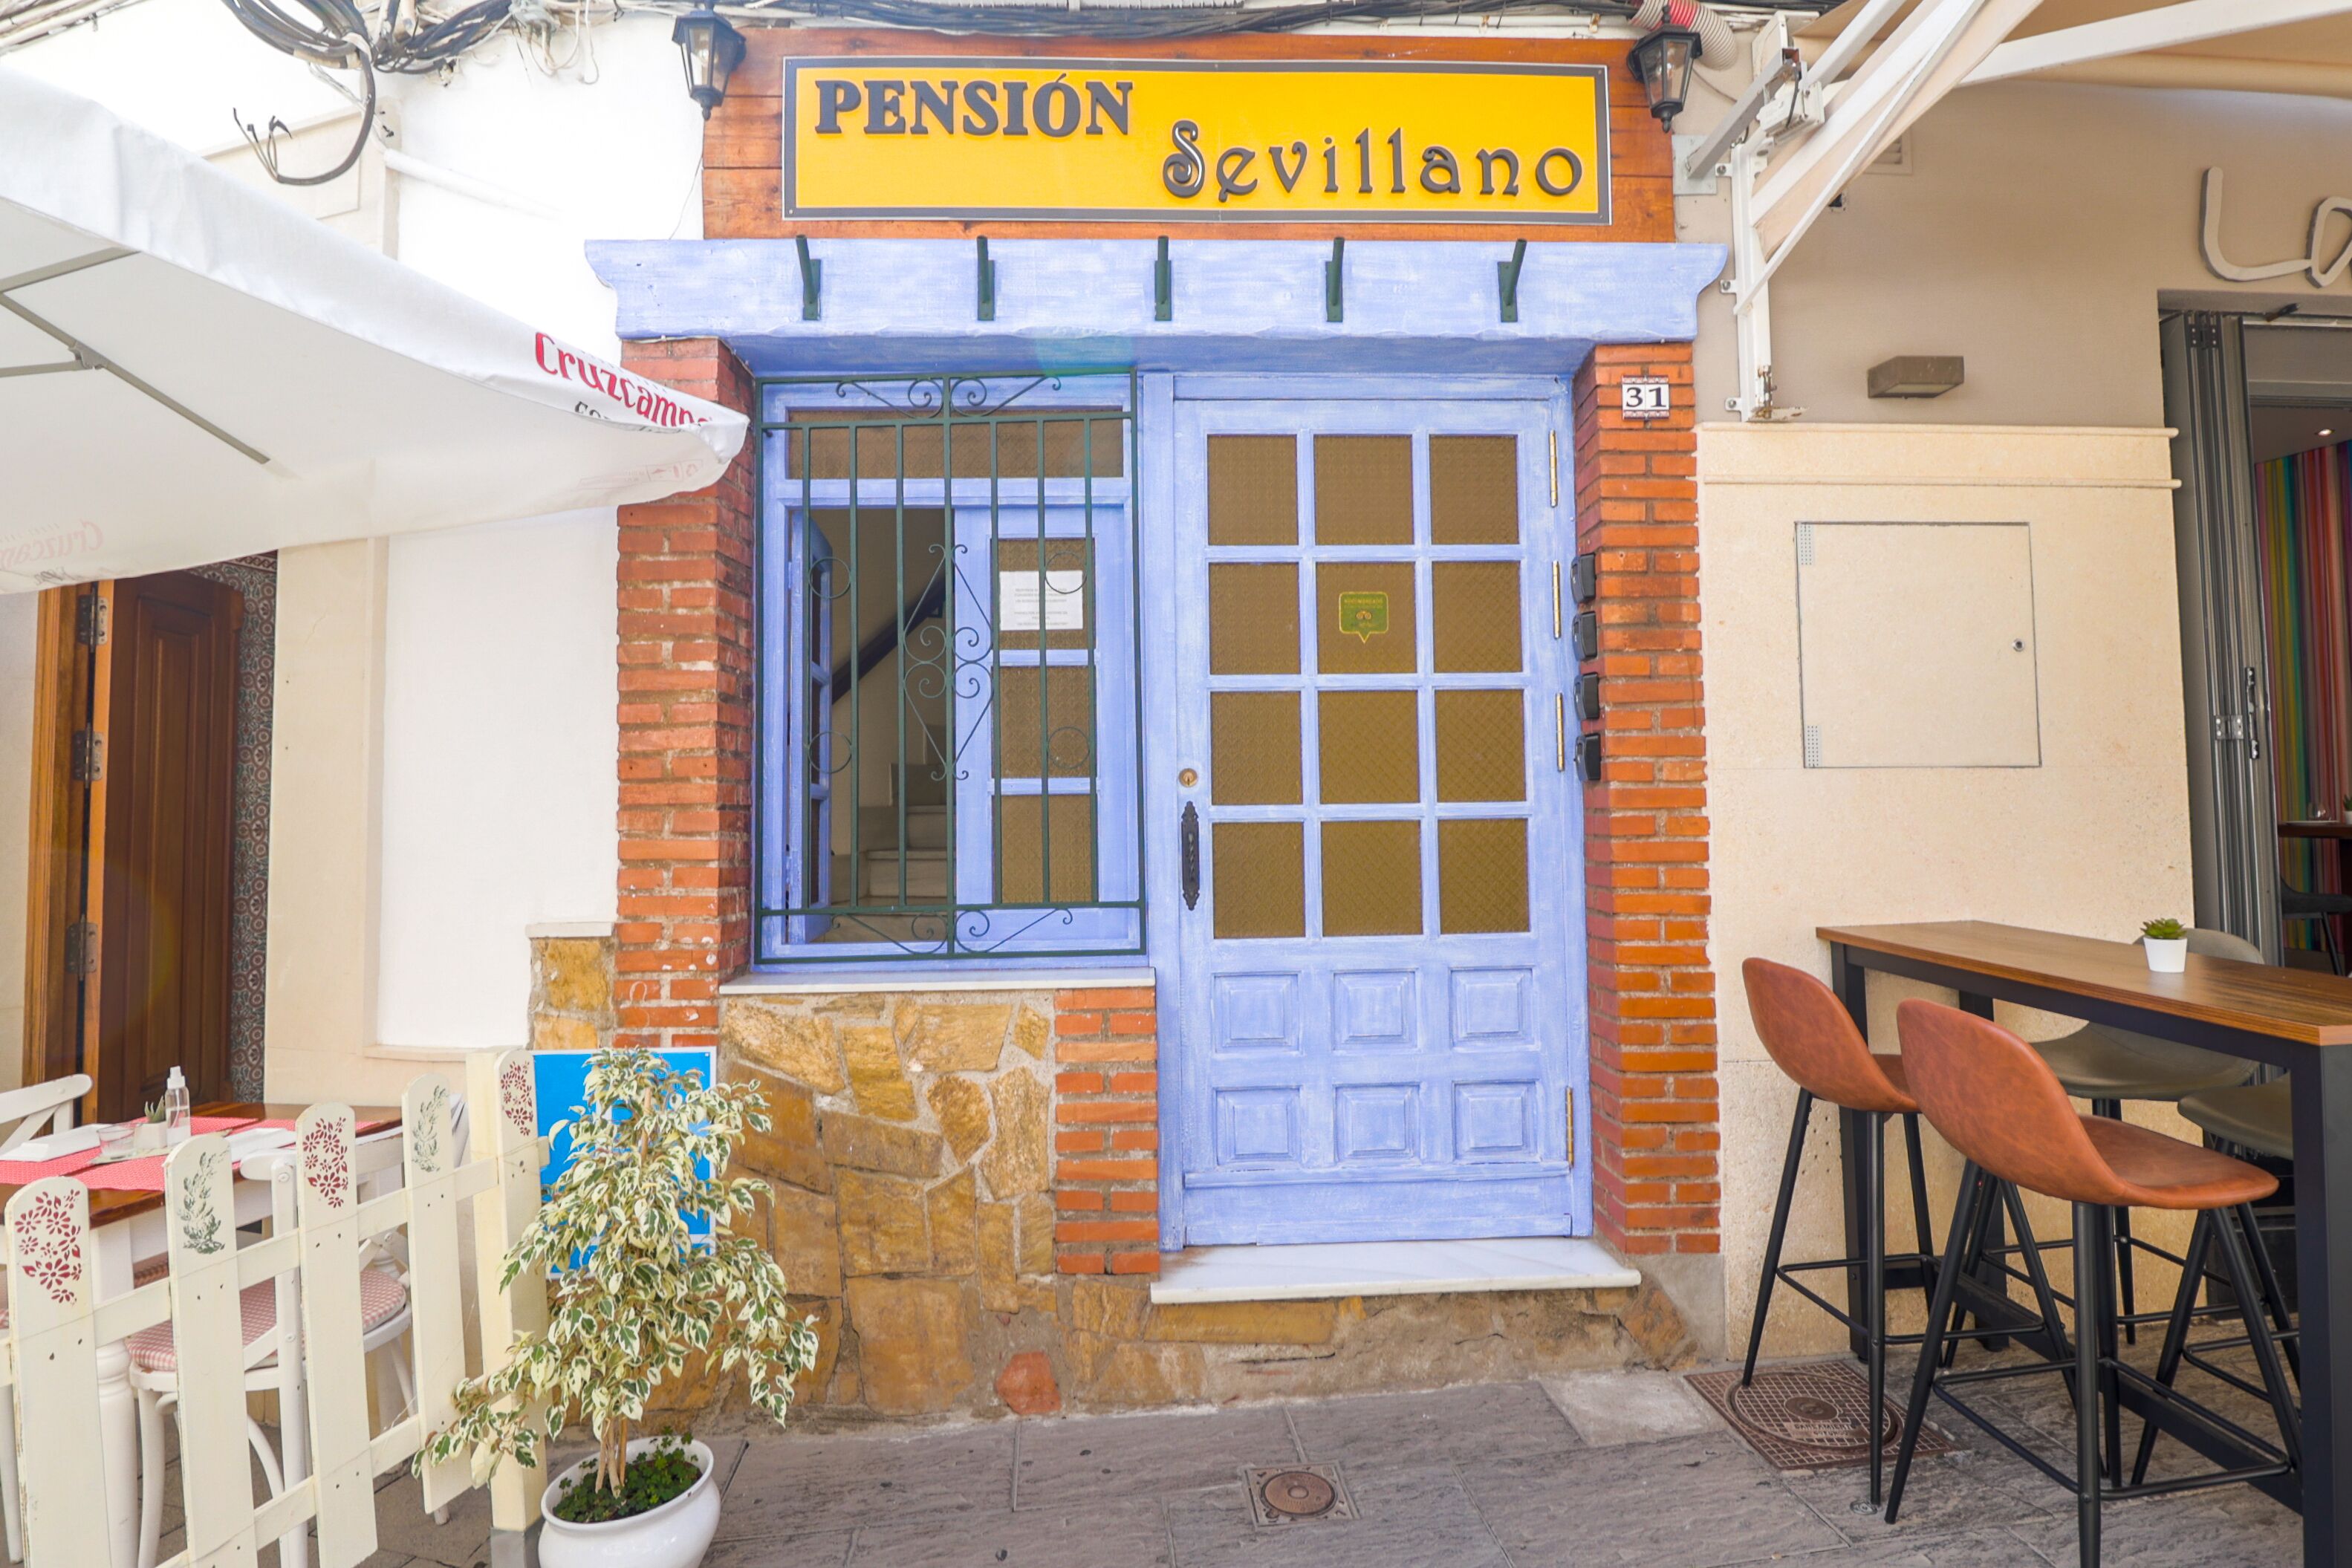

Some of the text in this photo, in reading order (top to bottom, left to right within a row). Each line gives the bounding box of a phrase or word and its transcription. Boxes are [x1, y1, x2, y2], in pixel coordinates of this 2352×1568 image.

[814, 73, 1134, 137] PENSIÓN
[1162, 119, 1583, 203] Sevillano
[1625, 386, 1667, 408] 31
